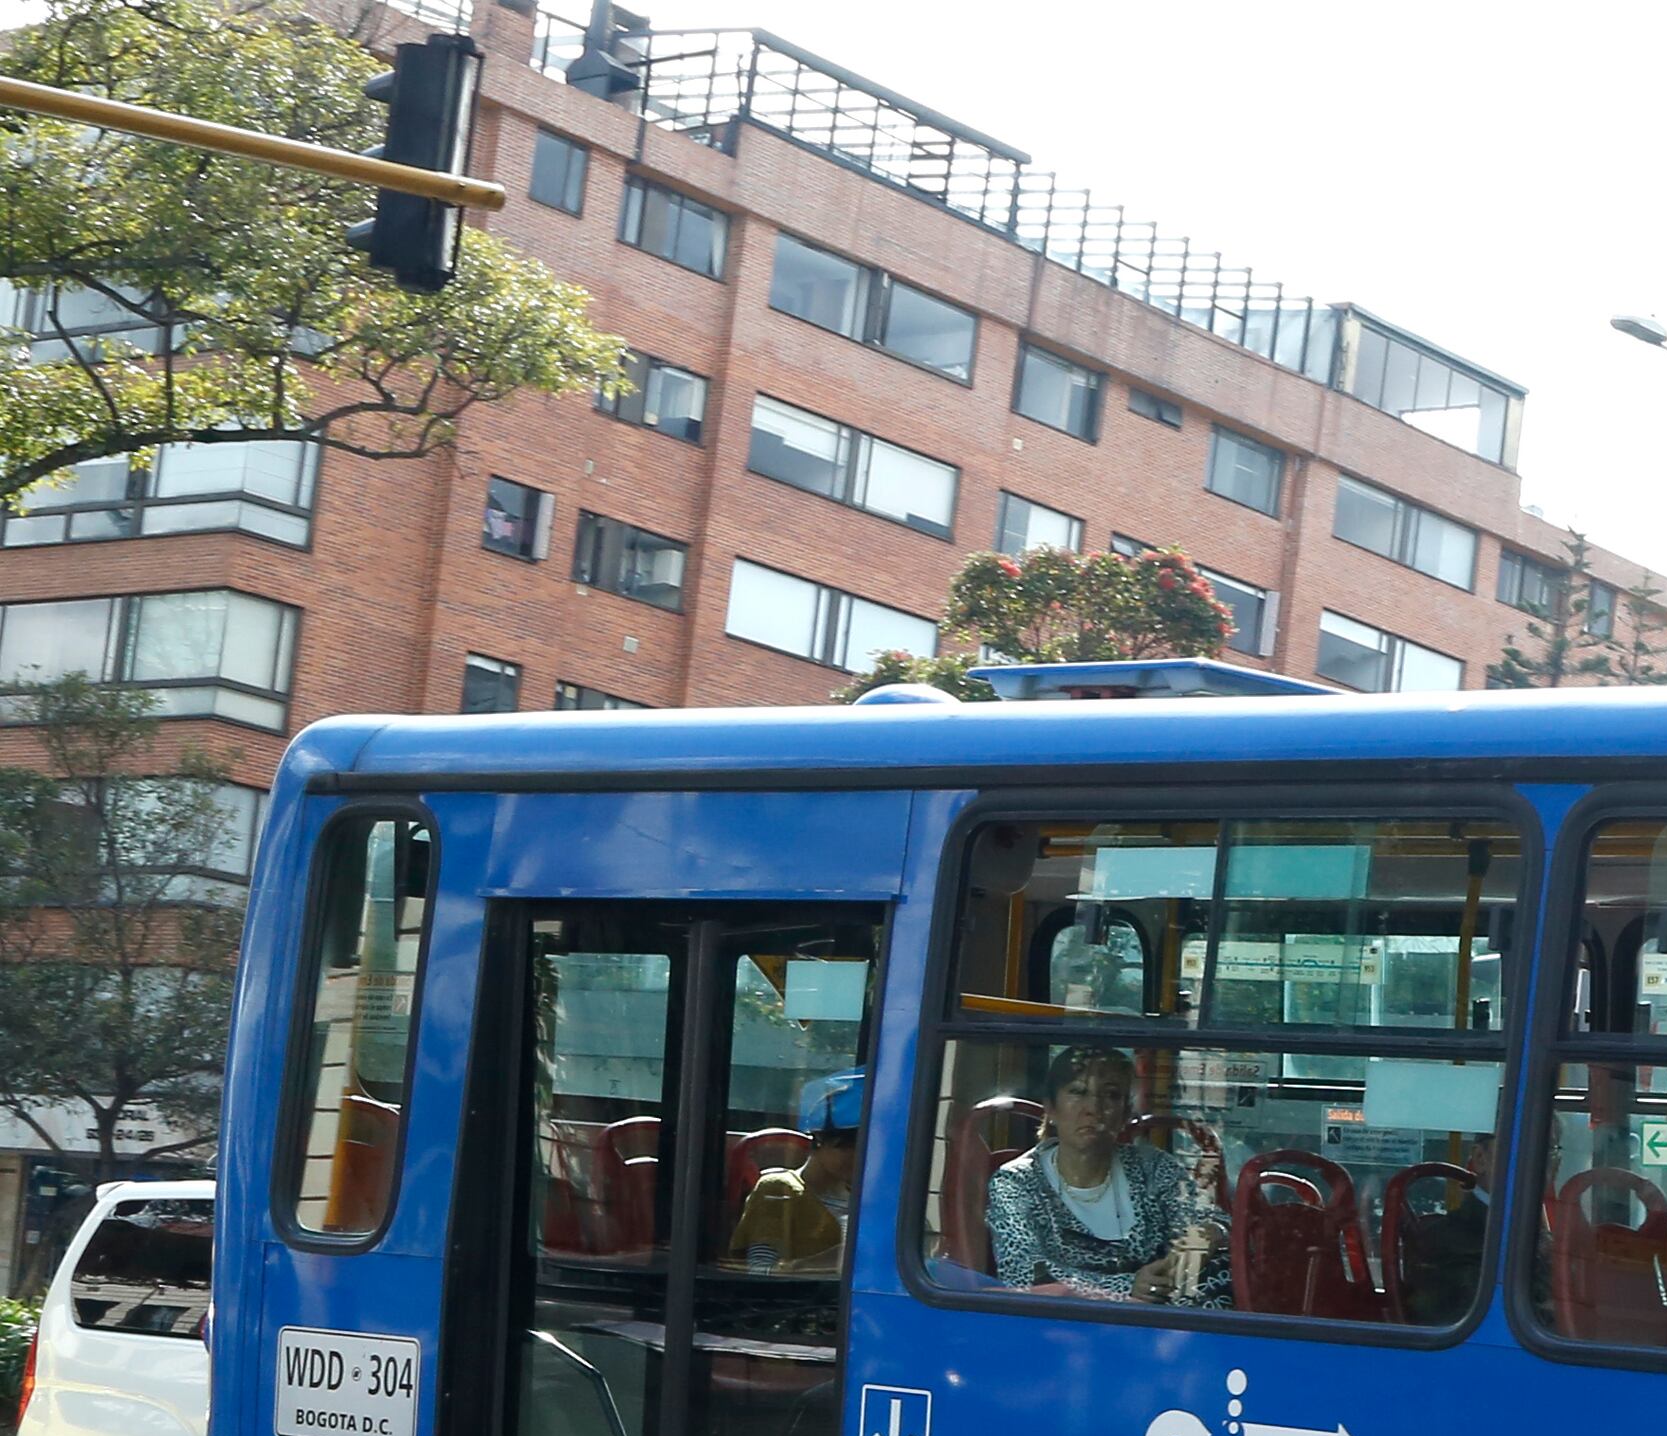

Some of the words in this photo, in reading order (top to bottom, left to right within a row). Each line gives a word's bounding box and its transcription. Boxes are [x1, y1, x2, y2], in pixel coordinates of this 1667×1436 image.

[286, 1346, 344, 1391] WDD
[368, 1354, 413, 1399] 304
[295, 1409, 357, 1431] BOGOTA
[362, 1416, 393, 1435] D.C.
